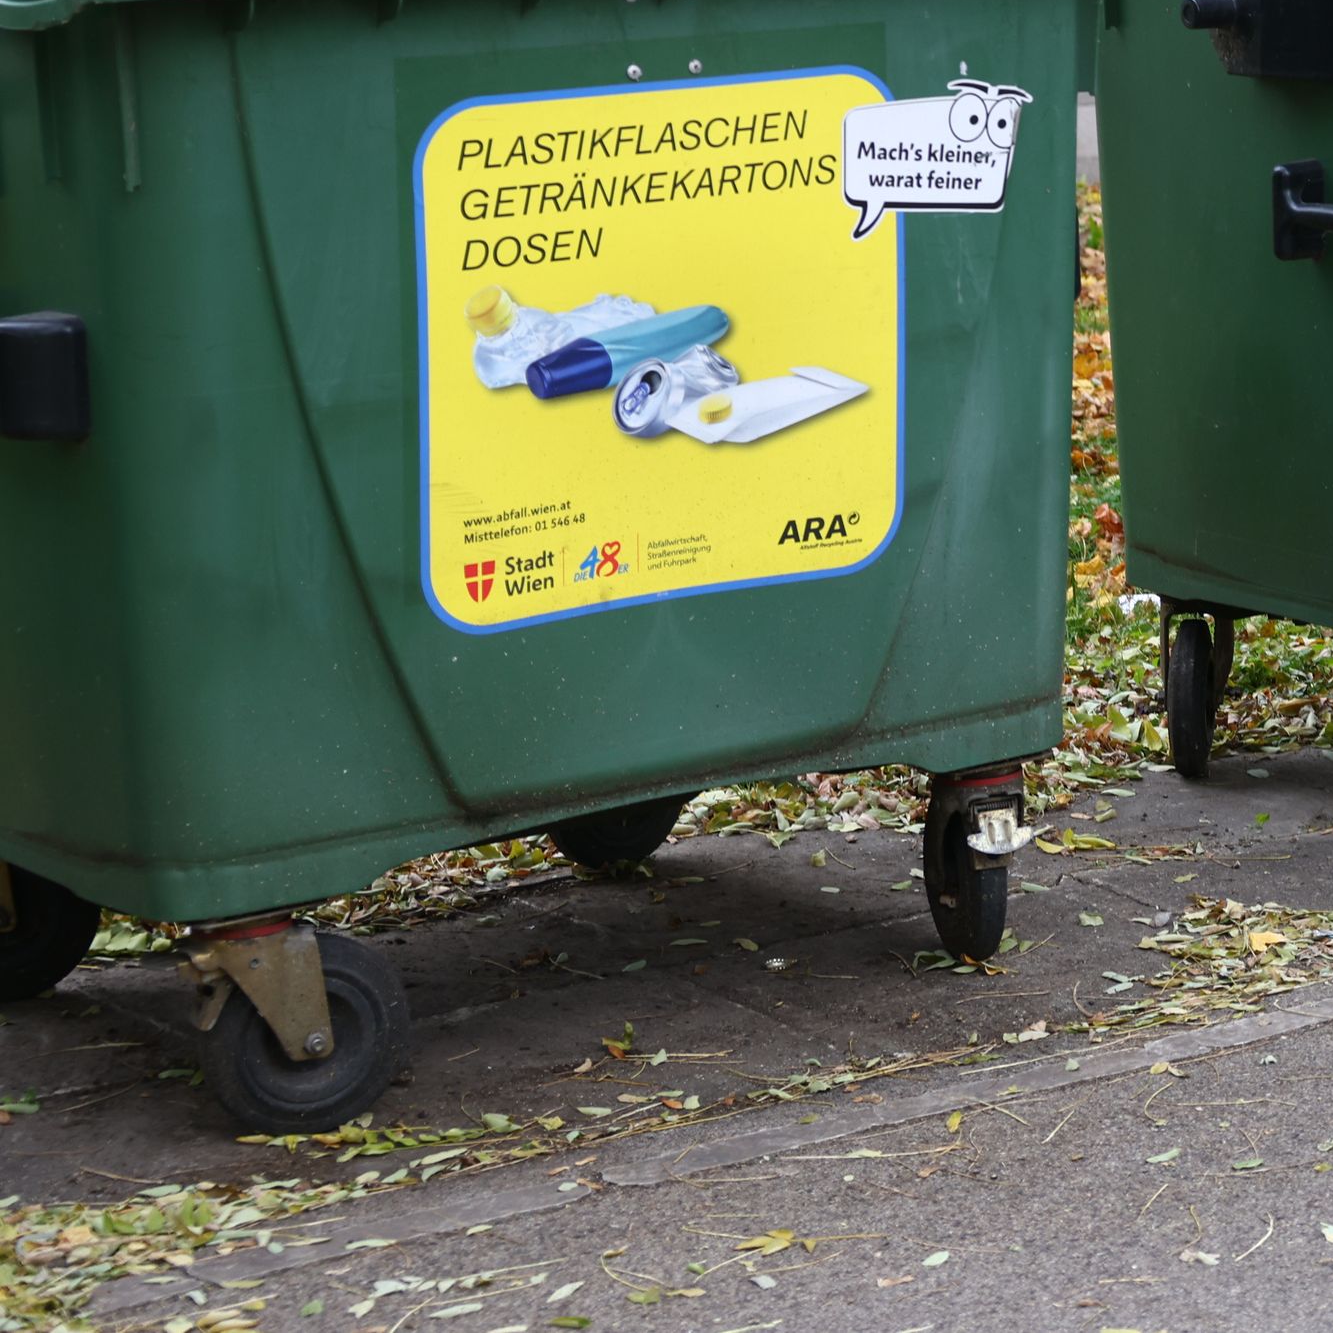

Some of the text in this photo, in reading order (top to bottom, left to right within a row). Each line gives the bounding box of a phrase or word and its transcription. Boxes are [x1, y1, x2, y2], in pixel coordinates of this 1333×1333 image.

[457, 109, 807, 171] PLASTIKFLASCHEN
[857, 141, 996, 167] Mach's kleiner,
[460, 154, 837, 221] GETRÄNKEKARTONS
[869, 170, 982, 190] warat feiner
[462, 227, 604, 271] DOSEN
[463, 500, 571, 528] www.abfall.wien.at
[464, 513, 586, 544] Misttelefon: 01 546 48
[647, 533, 708, 550] Abfallwirtschaft,
[777, 514, 847, 545] ARA
[504, 550, 555, 576] Stadt
[647, 544, 712, 561] Straßenreinigung
[647, 556, 697, 571] und Fuhrpark
[504, 575, 555, 597] Wien
